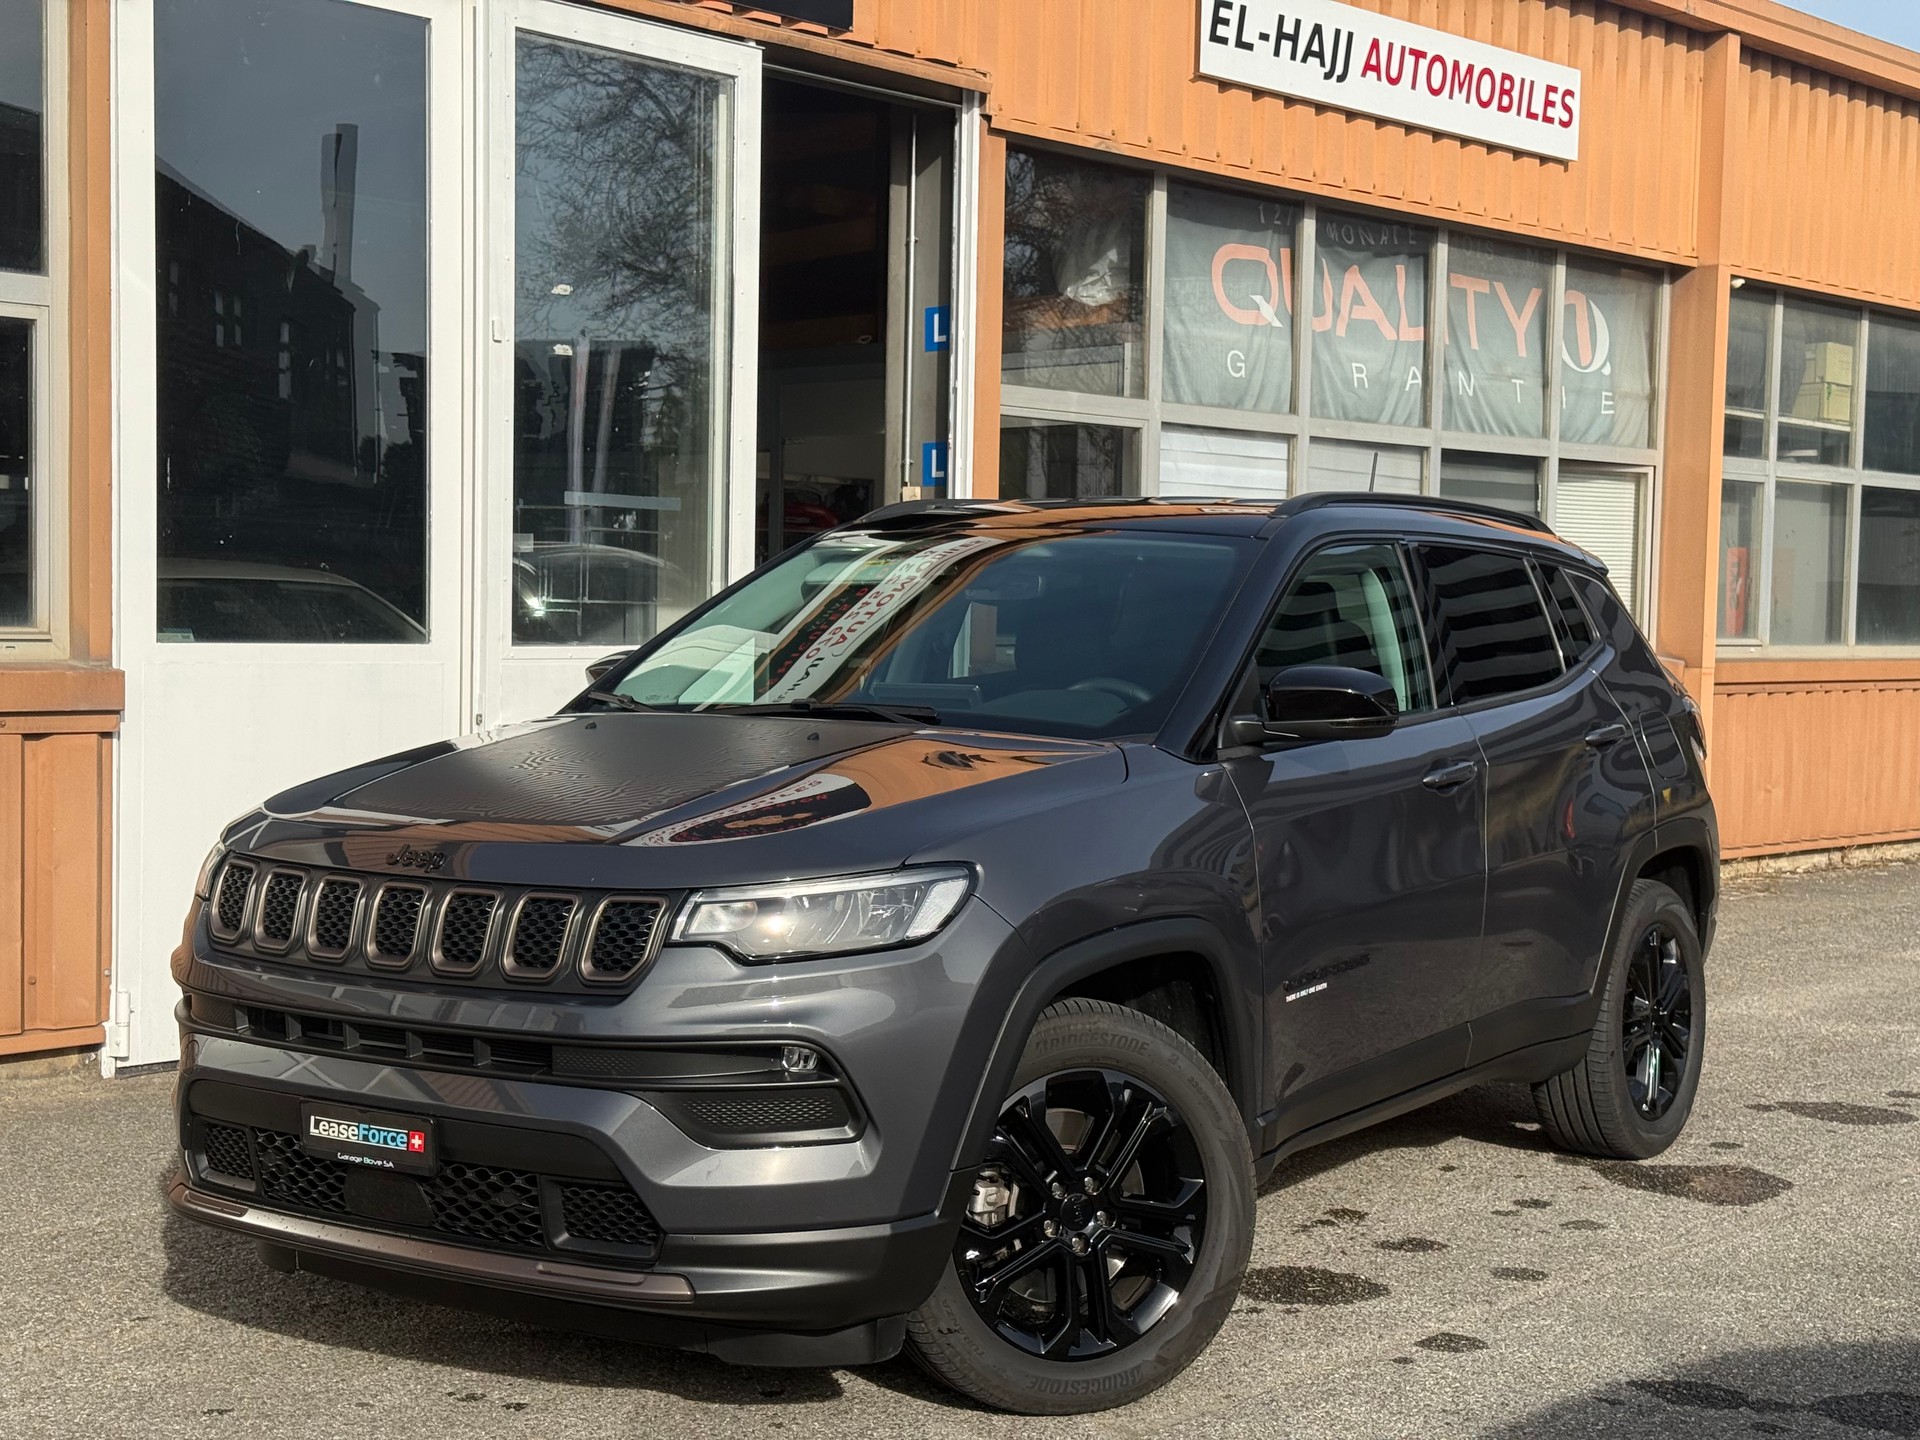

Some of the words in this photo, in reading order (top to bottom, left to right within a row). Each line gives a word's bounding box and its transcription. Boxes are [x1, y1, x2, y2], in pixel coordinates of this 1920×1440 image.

[1209, 0, 1354, 83] EL-HAJJ
[1360, 37, 1575, 129] AUTOMOBILES
[1326, 221, 1417, 246] MONATE
[1211, 243, 1543, 358] QUALTY
[933, 313, 947, 343] L
[1227, 349, 1615, 415] GRANTIE
[931, 448, 945, 478] L
[385, 843, 447, 873] Jeep
[1035, 1031, 1150, 1056] BRIDGESTONE
[310, 1115, 408, 1148] LeaseForce
[337, 1152, 363, 1164] Garage
[383, 1160, 395, 1169] SA
[1026, 1365, 1145, 1395] BRIDGESTONE
